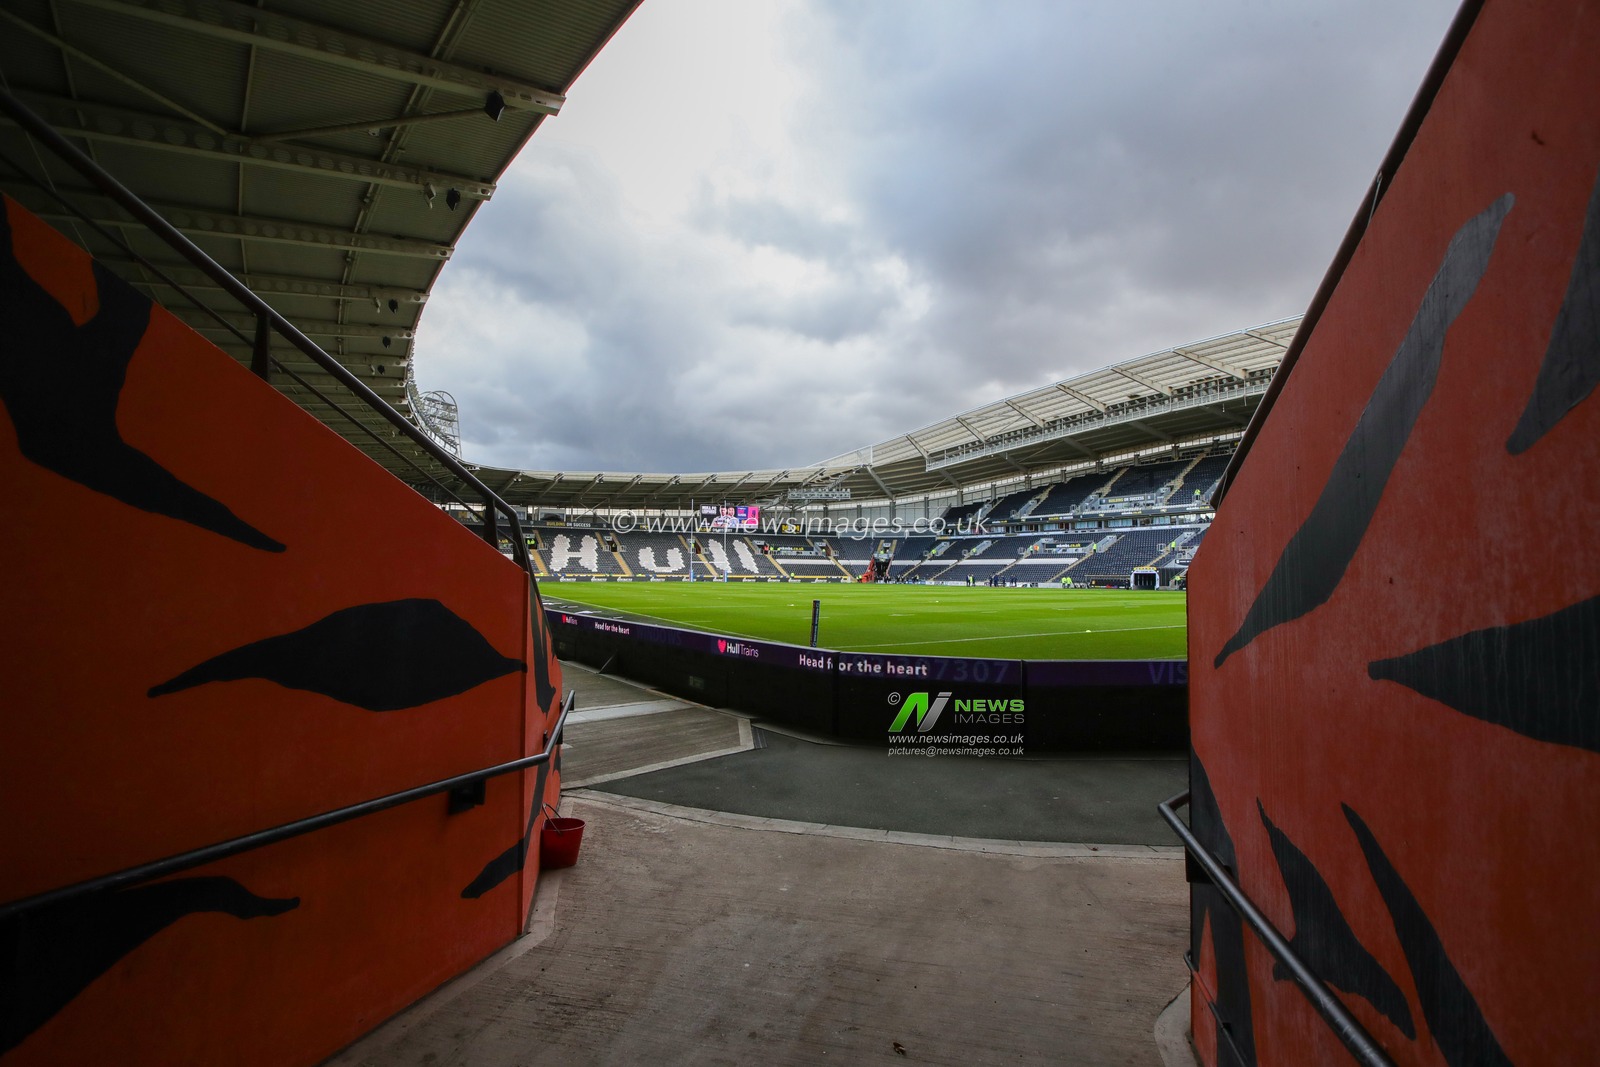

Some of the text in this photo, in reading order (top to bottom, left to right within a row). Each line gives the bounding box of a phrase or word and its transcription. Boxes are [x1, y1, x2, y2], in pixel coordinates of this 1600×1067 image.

[594, 621, 604, 631] Head
[618, 625, 630, 635] heart
[799, 653, 824, 669] Head
[856, 660, 882, 673] the
[887, 661, 928, 676] heart
